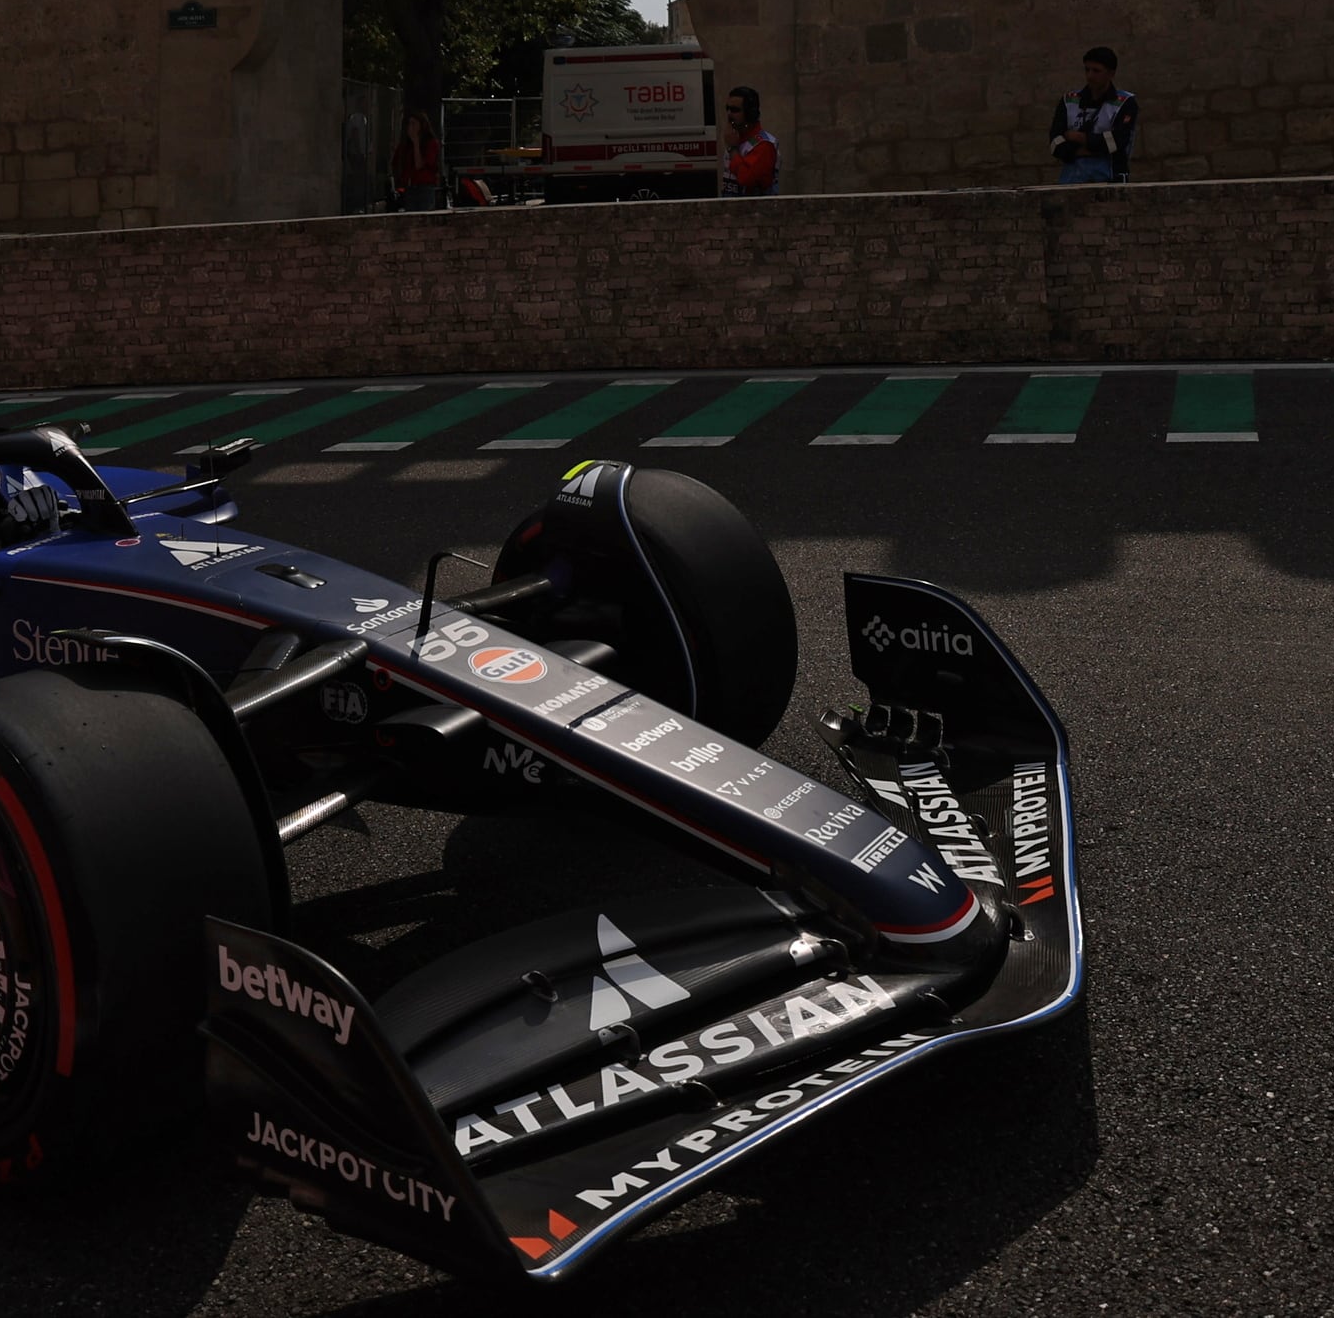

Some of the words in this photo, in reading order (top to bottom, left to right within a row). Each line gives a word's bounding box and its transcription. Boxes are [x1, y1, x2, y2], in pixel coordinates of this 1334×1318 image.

[555, 494, 593, 508] ATLASSIAN
[190, 545, 266, 571] ATLASSIAN
[406, 617, 490, 662] 55
[899, 622, 974, 657] airia
[484, 648, 538, 682] Gulf
[532, 675, 610, 715] KOMATSU
[620, 715, 685, 754] betway
[736, 761, 774, 786] VAST
[777, 781, 816, 816] KEEPER
[1012, 761, 1052, 879] MYPROTEIN
[804, 803, 866, 848] Reviva
[899, 761, 1006, 888] ATLASSIAN
[851, 825, 909, 874] PIRELLI
[217, 944, 357, 1046] betway
[454, 974, 897, 1157] ATLASSIAN
[575, 1033, 935, 1211] MYPROTEIN
[246, 1111, 378, 1190] JACKPOT
[381, 1165, 459, 1224] CITY
